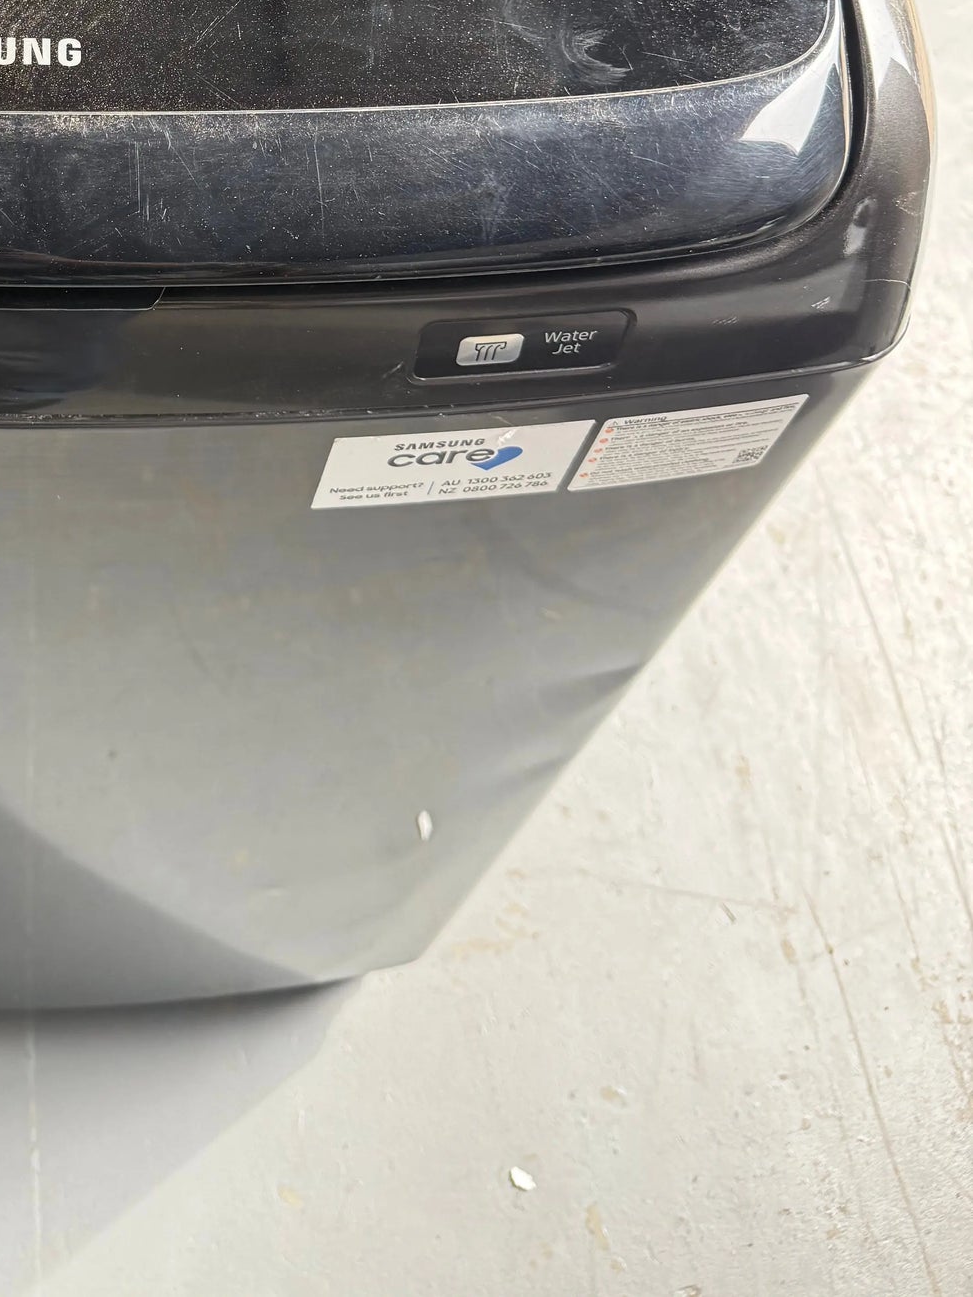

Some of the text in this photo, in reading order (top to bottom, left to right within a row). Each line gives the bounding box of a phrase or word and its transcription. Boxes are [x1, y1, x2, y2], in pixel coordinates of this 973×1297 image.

[545, 330, 599, 343] Water
[551, 342, 581, 355] Jet
[394, 438, 486, 452] SAMSUNG
[387, 448, 496, 468] care
[441, 472, 553, 487] AU 1300 362 603
[329, 482, 425, 494] Need support?
[383, 490, 409, 498] first
[463, 484, 498, 493] 0800
